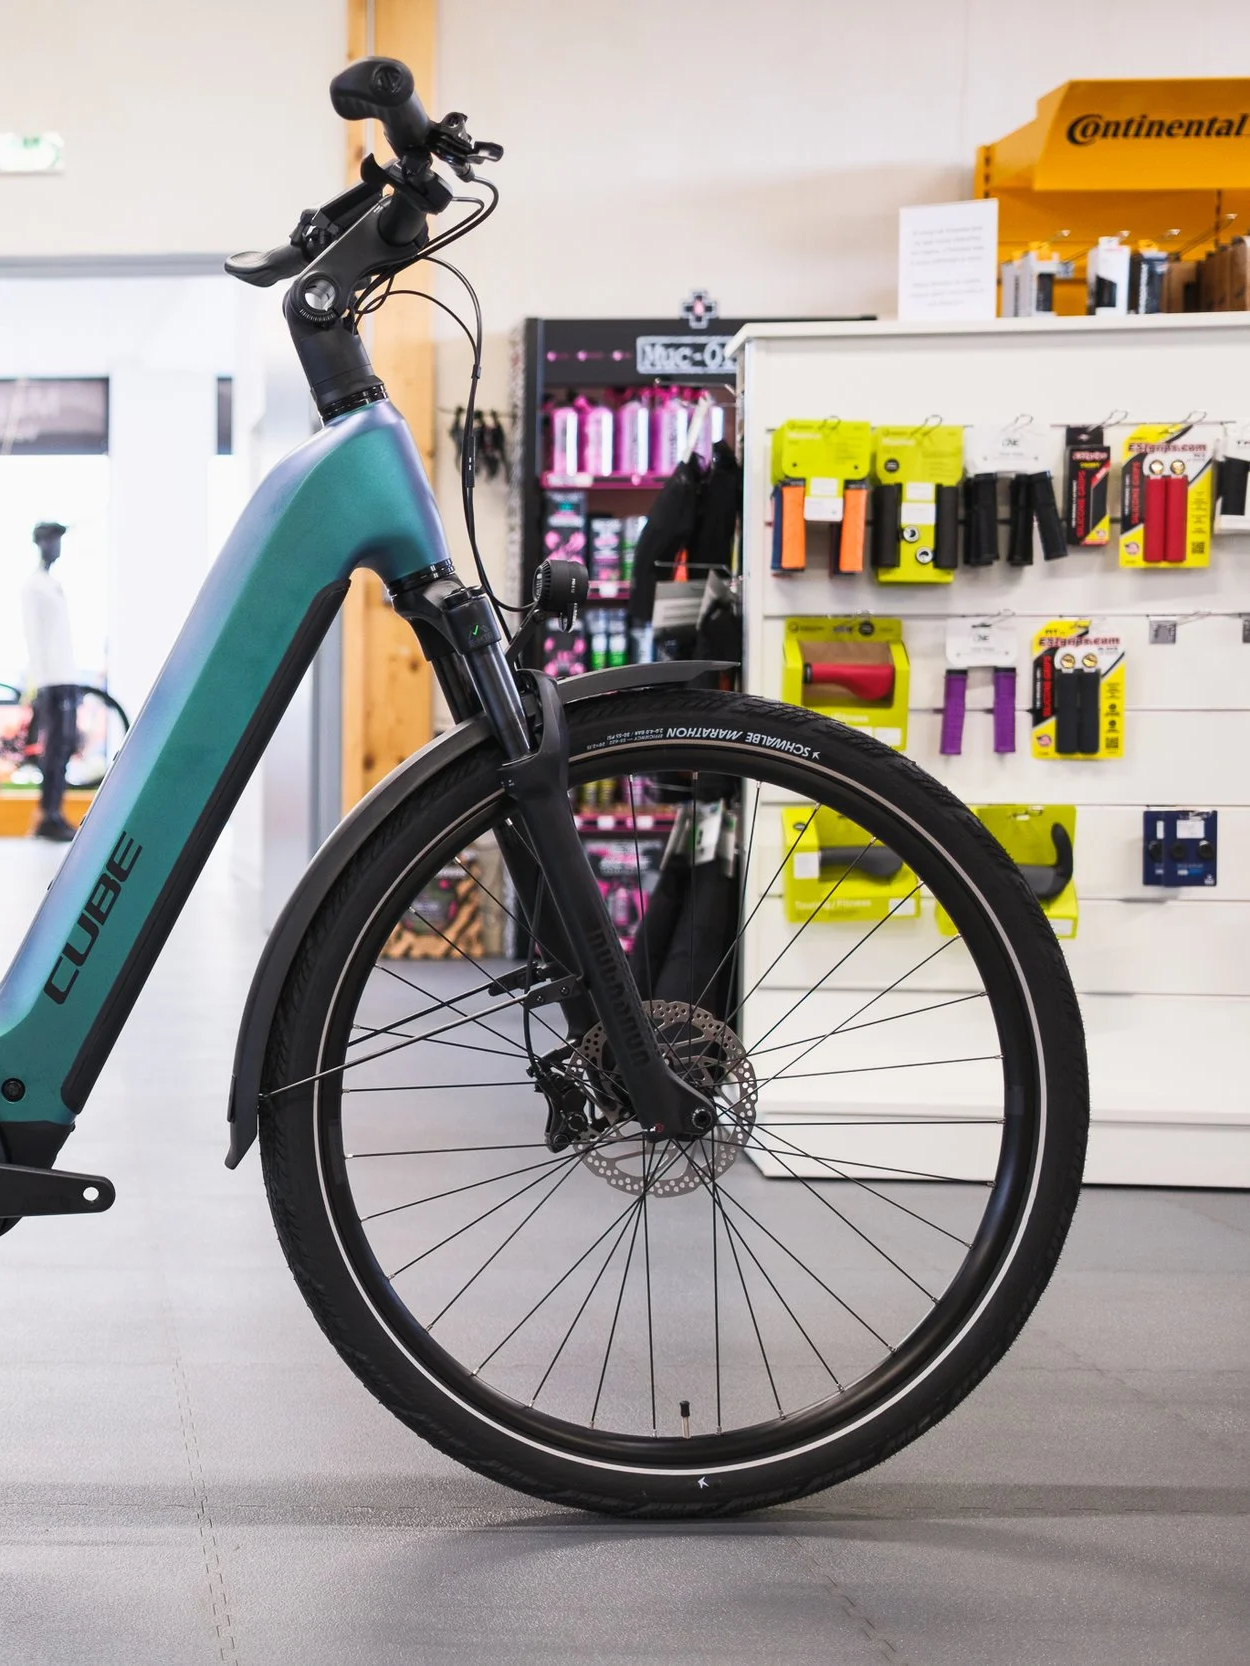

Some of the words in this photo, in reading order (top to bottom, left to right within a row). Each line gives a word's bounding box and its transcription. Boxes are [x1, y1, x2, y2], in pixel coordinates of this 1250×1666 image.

[1066, 113, 1248, 147] Continental
[666, 727, 743, 740] MARATHON
[745, 732, 811, 758] SCHWALBE
[43, 831, 143, 1005] CUBE
